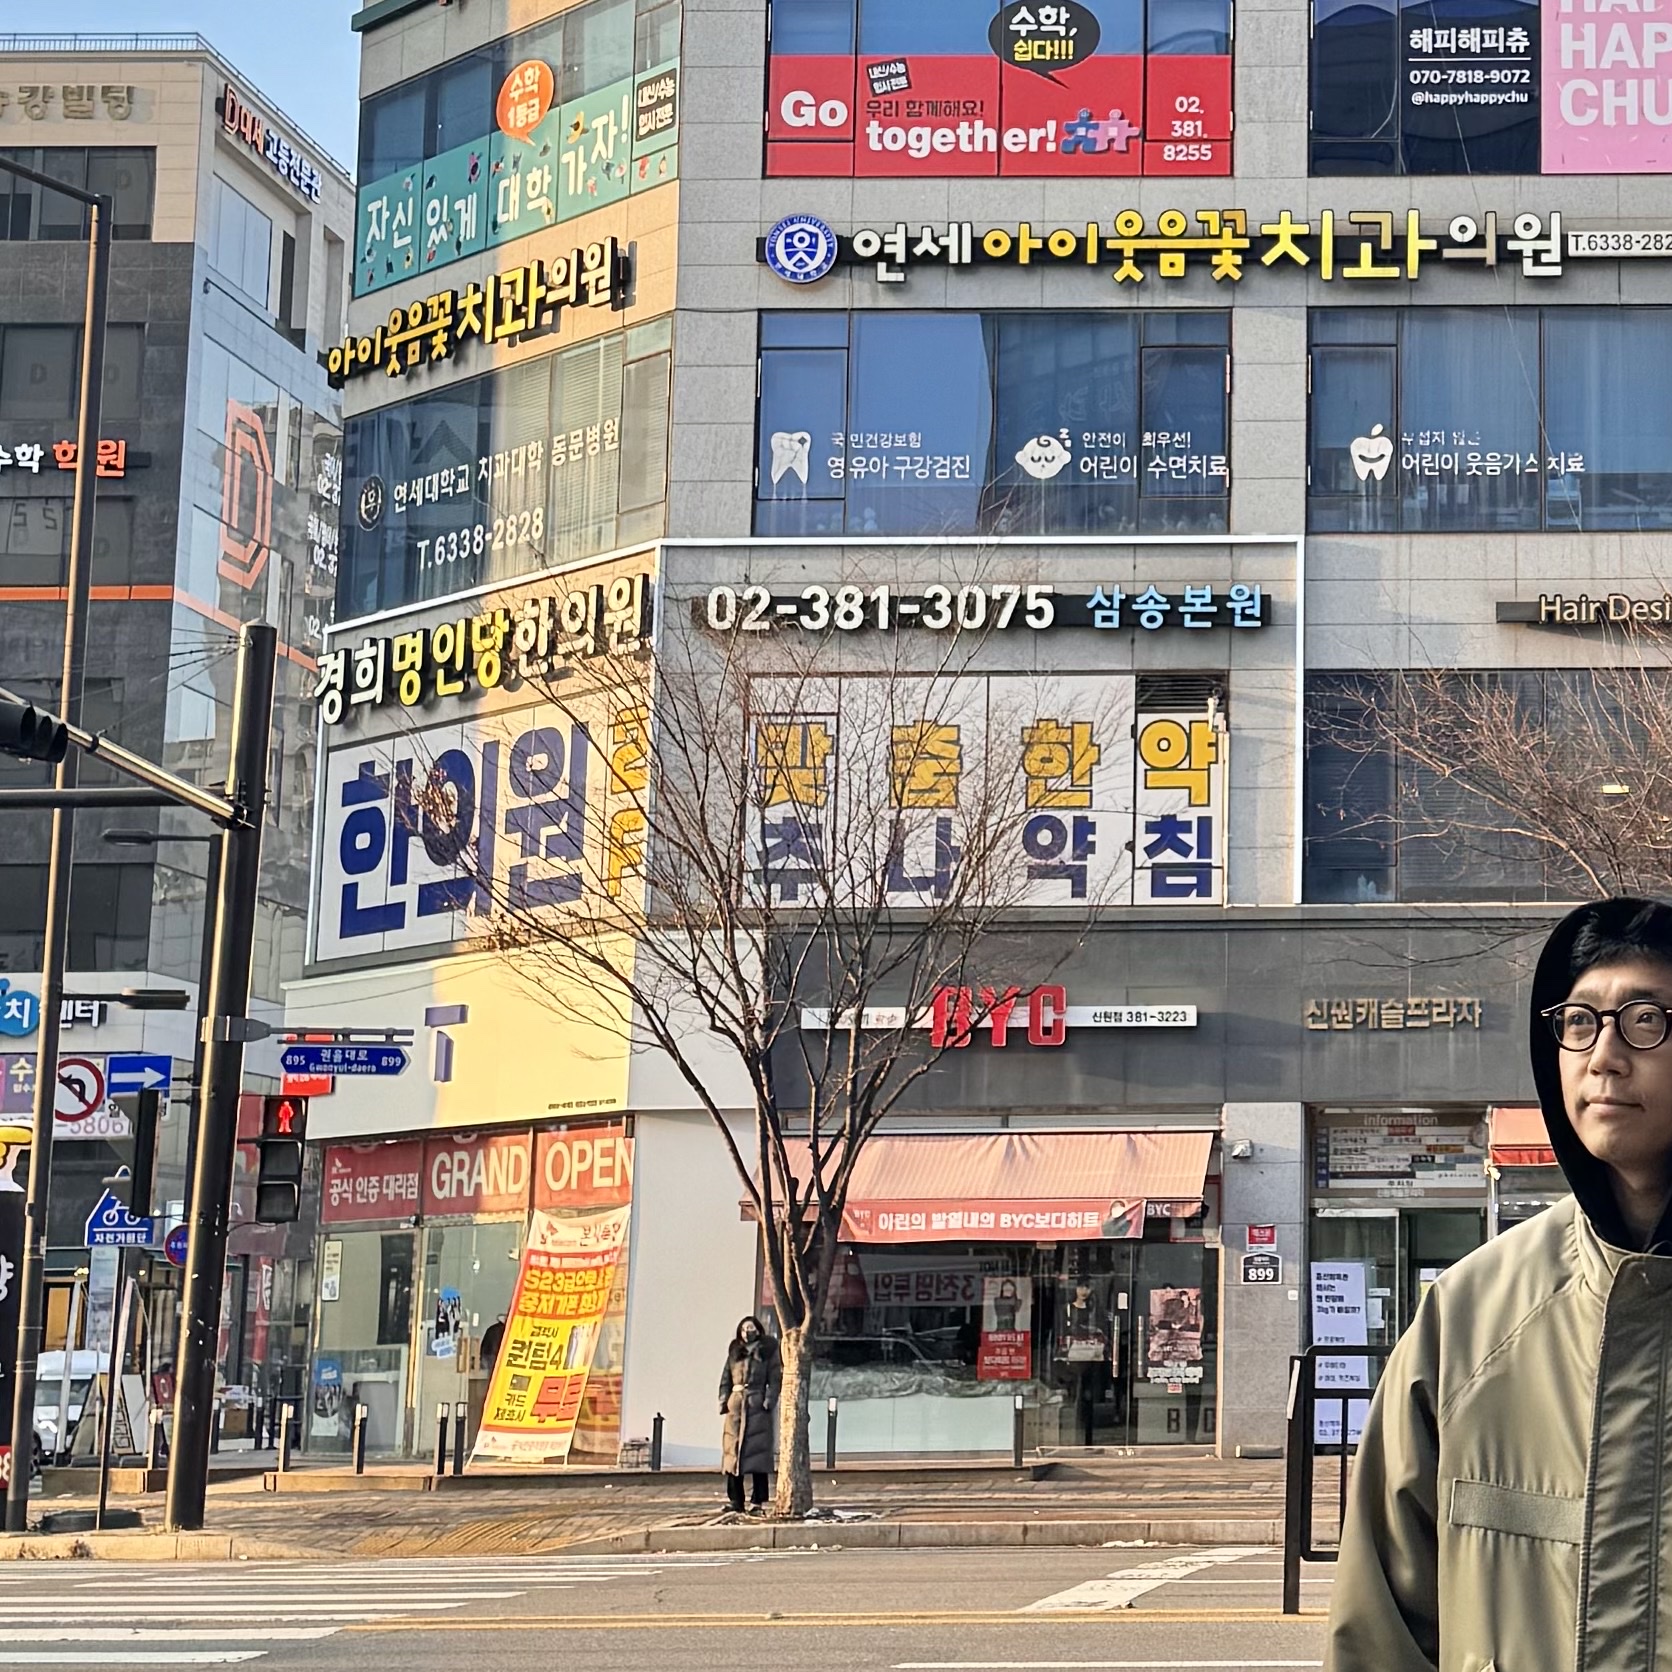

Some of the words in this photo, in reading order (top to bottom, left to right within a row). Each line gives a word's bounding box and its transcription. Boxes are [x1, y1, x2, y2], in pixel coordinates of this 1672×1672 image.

[1008, 5, 1078, 37] 수학,
[1013, 39, 1075, 62] 쉽다!!!
[1409, 26, 1531, 54] 해피해피츄
[508, 64, 541, 101] 수학
[1409, 68, 1531, 86] 070-7818-9072
[780, 90, 849, 128] Go
[866, 100, 900, 118] 우리
[904, 99, 984, 119] 함께해요!
[1174, 96, 1205, 115] 02.
[1411, 89, 1529, 106] @happyhappychu
[507, 98, 540, 129] 1등급
[866, 119, 1057, 159] together!
[1170, 119, 1207, 140] 381.
[1163, 144, 1213, 162] 8255
[366, 195, 415, 249] 자신
[425, 192, 478, 249] 있게
[496, 164, 553, 225] 대학
[561, 94, 630, 196] 가자!
[327, 235, 617, 377] 아이웃음꽃치과의원
[831, 432, 922, 449] 국민건강보험
[1082, 431, 1126, 449] 안전이
[1141, 431, 1192, 450] 최우선!
[393, 464, 470, 514] 연세대학교
[477, 440, 544, 482] 치과대학
[551, 417, 620, 467] 동문병원
[826, 455, 888, 480] 영유아
[893, 454, 971, 480] 구강검진
[1079, 455, 1138, 480] 어린이
[1147, 454, 1228, 480] 수면치료
[1401, 451, 1460, 476] 어린이
[1465, 451, 1540, 477] 웃음가스
[416, 506, 545, 571] T.6338-2828
[706, 582, 1056, 631] 02-381-3075
[1085, 582, 1263, 628] 삼송본원
[1539, 594, 1600, 623] Hair
[339, 720, 589, 940] 한의원
[930, 983, 1067, 1047] BYC
[1091, 1010, 1122, 1024] 신원점
[1126, 1009, 1188, 1023] 381-3223
[1304, 996, 1483, 1031] 신원캐슬프라자
[285, 1055, 306, 1066] 895
[381, 1055, 401, 1067] 899
[1363, 1114, 1439, 1126] information
[431, 1144, 529, 1201] GRAND
[544, 1135, 633, 1192] OPEN
[328, 1175, 353, 1207] 공식
[355, 1175, 380, 1205] 인증
[382, 1172, 419, 1201] 대리점
[931, 1210, 995, 1231] 발열내의
[1000, 1210, 1100, 1230] BYC보디히트
[1147, 1203, 1171, 1217] BYC
[1248, 1268, 1274, 1281] 899
[504, 1392, 527, 1408] 카드
